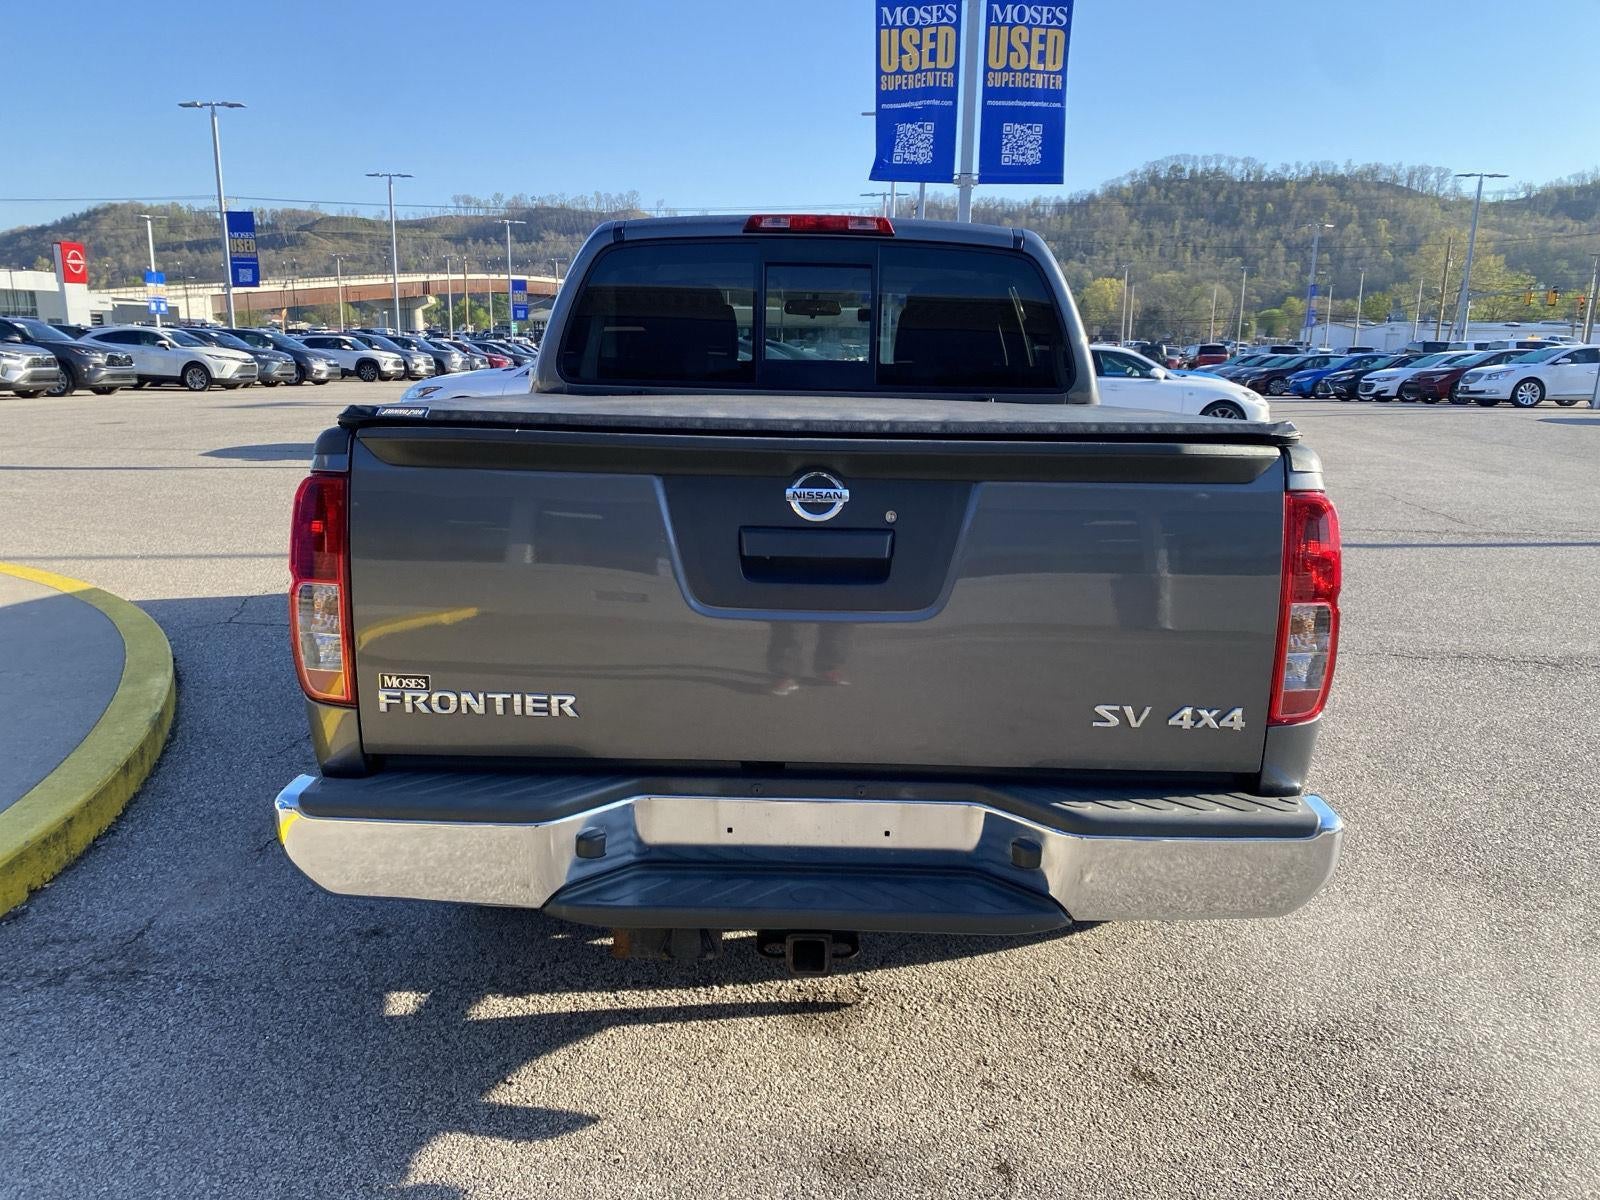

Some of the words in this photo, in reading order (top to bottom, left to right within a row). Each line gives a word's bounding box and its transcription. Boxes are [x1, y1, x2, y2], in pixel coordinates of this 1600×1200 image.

[881, 4, 957, 26] MOSES
[991, 4, 1068, 26] MOSES
[880, 26, 956, 73] USED
[988, 26, 1066, 71] USED
[881, 71, 954, 91] SUPERCENTER
[987, 71, 1062, 90] SUPERCENTER
[987, 100, 1062, 108] mosesusedsupercenter.com
[229, 231, 255, 239] MOSES
[230, 239, 256, 253] USED
[792, 490, 842, 499] NISSAN
[383, 675, 426, 690] MOSES
[378, 690, 580, 718] FRONTIER
[1092, 704, 1152, 728] SV
